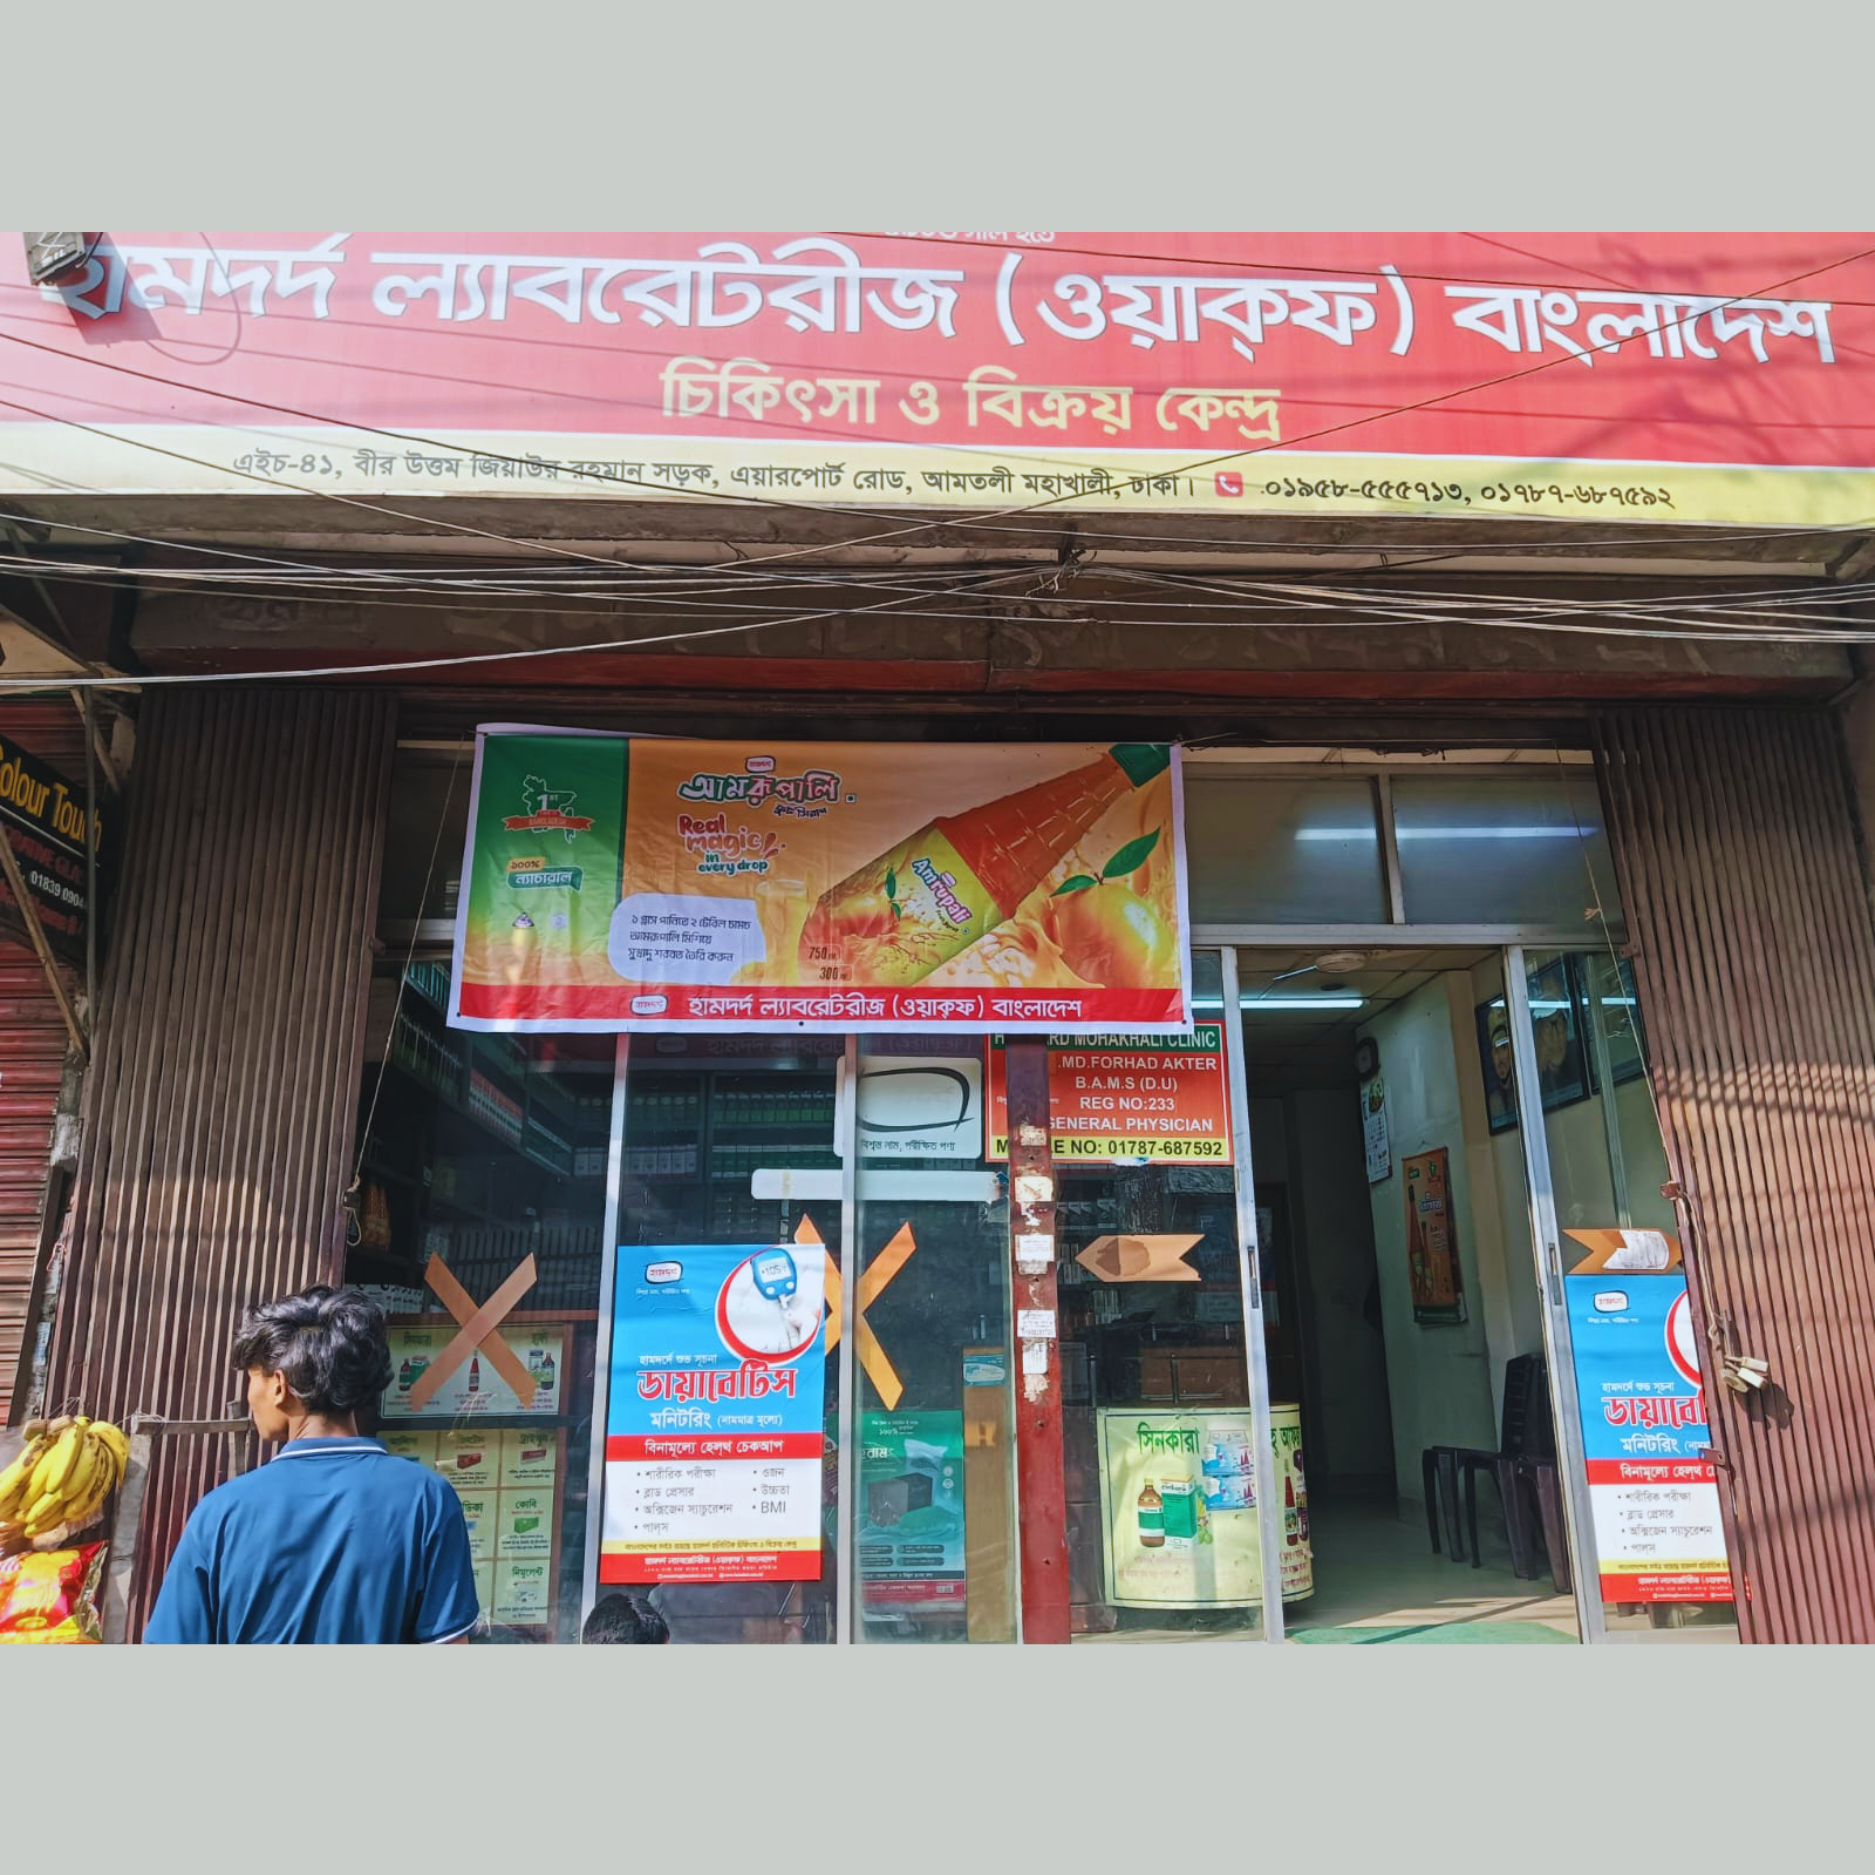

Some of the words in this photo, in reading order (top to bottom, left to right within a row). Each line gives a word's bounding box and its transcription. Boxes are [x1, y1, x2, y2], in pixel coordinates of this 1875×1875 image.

[371, 237, 965, 338] ল্যাবরেটরীজ
[1444, 286, 1837, 367] বাংলাদেশ
[660, 355, 881, 424] চিকিৎসা
[899, 380, 941, 426] ও
[963, 365, 1134, 435] বিক্রয়
[1156, 388, 1281, 441] কেন্দ্র
[353, 448, 397, 476] বীর
[404, 450, 463, 478] উত্তম
[471, 452, 559, 480] জিয়াউর
[568, 459, 646, 483] রহমান
[652, 462, 720, 489] সড়ক,
[731, 461, 847, 489] এয়ারপোর্ট
[853, 469, 913, 495] রোড,
[921, 465, 1015, 494] আমতলী
[1022, 467, 1121, 499] মহাখালী,
[1481, 483, 1677, 510] ০১৭৮৭-৬৮৭৫৯২
[0, 744, 51, 818] olour
[52, 781, 103, 851] Touh
[678, 813, 727, 836] Real
[686, 828, 762, 858] magic
[511, 860, 540, 870] ১০০%
[698, 861, 736, 875] every
[737, 859, 768, 873] drop
[705, 851, 719, 862] in
[911, 856, 973, 924] Amrupali
[819, 966, 839, 980] 300
[688, 994, 754, 1017] হামদর্দ
[759, 992, 886, 1017] ল্যাবরেটরীজ
[992, 999, 1082, 1019] বাংলাদেশ
[1074, 1033, 1163, 1047] MOHAKHALI
[1167, 1031, 1216, 1048] CLINIC
[1162, 1057, 1217, 1071] AKTER
[1075, 1077, 1135, 1090] B.A.M.S
[1140, 1077, 1178, 1092] (D.U)
[1080, 1097, 1114, 1110] REG
[1119, 1097, 1175, 1111] NO:233
[1049, 1117, 1121, 1130] GENERAL
[1126, 1118, 1213, 1132] PHYSICIAN
[1071, 1140, 1102, 1154] NO:
[1108, 1140, 1222, 1155] 01787-687592
[636, 1358, 798, 1404] ডায়াবেটিস
[650, 1407, 711, 1429] মনিটরিং
[1136, 1421, 1200, 1454] সিনকারা
[1620, 1432, 1682, 1453] মনিটরিং
[644, 1438, 697, 1459] বিনামূল্যে
[736, 1440, 784, 1454] চেকআপ
[761, 1501, 787, 1514] BMI
